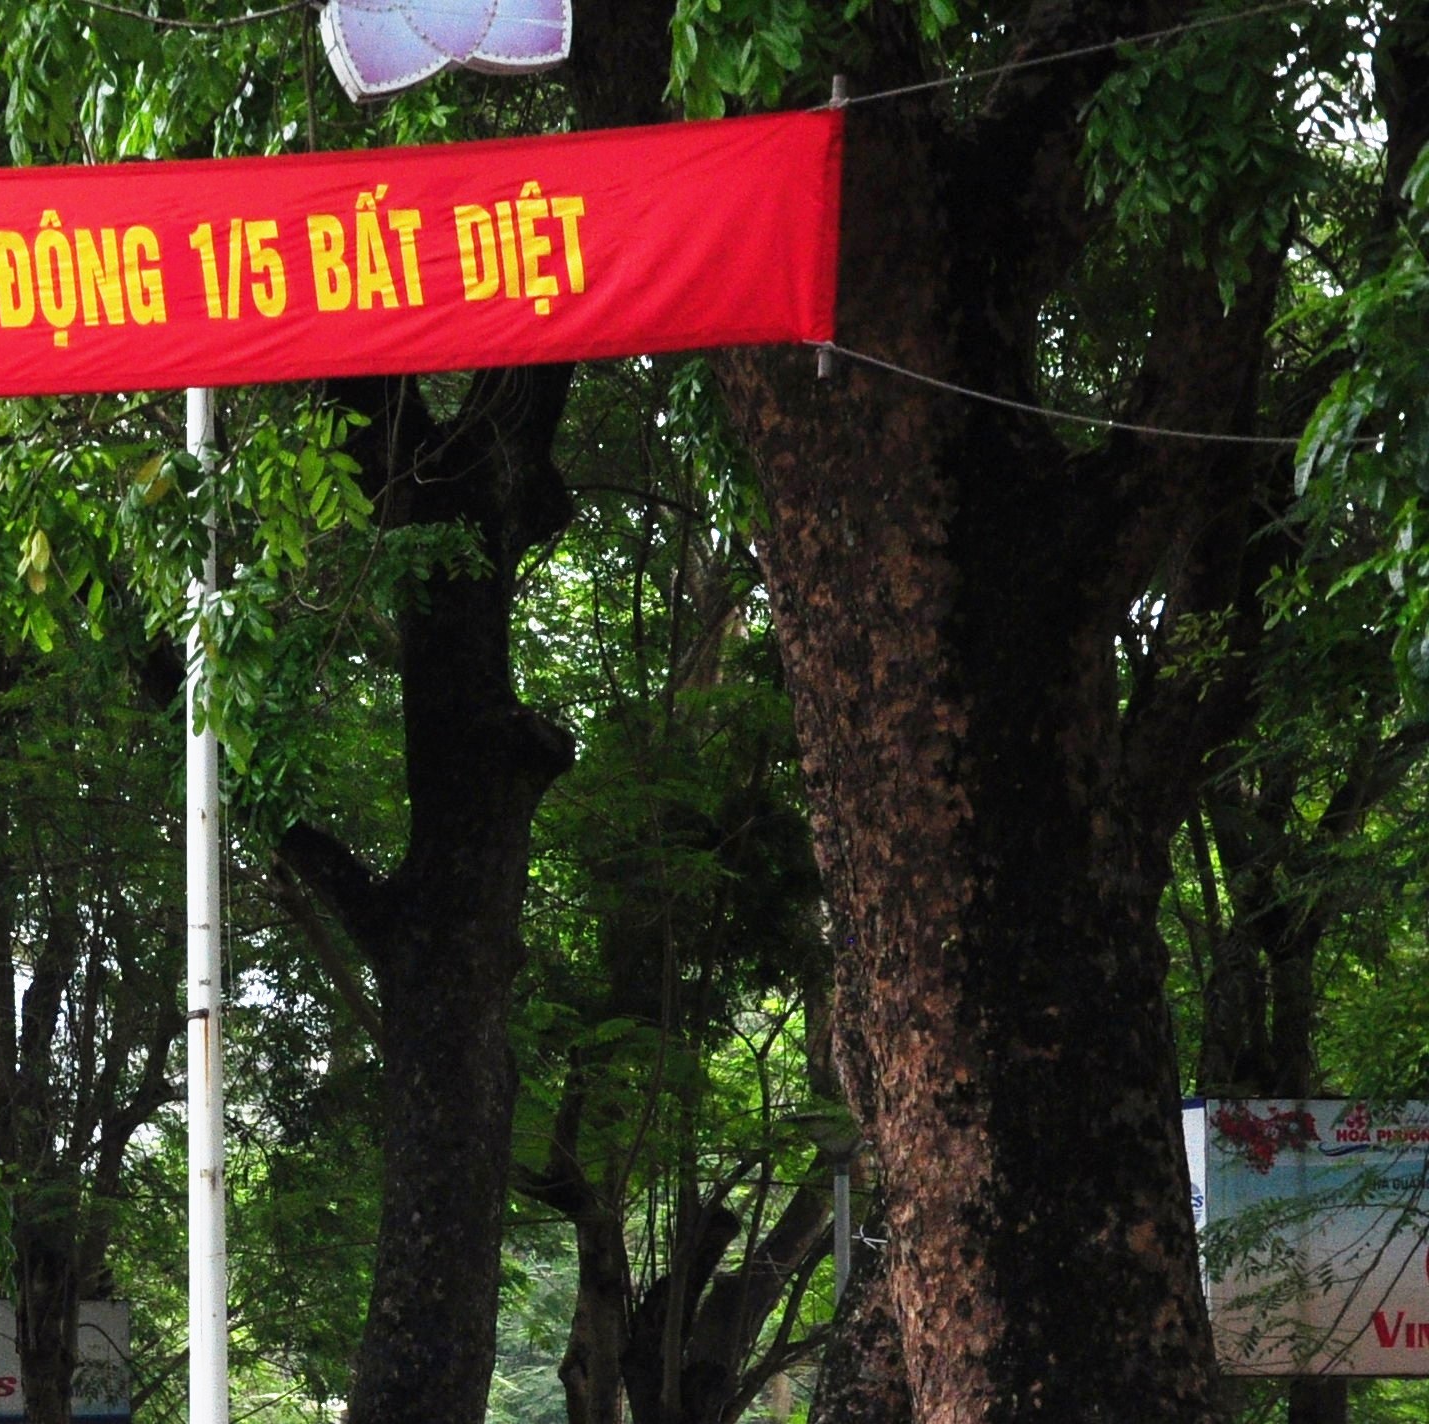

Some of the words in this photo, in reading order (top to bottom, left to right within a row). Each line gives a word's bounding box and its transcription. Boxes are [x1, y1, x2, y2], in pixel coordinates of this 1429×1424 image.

[189, 218, 287, 319] 1/5
[307, 184, 424, 311] BẤT
[453, 181, 585, 315] DIỆT
[1336, 1129, 1370, 1142] HOA
